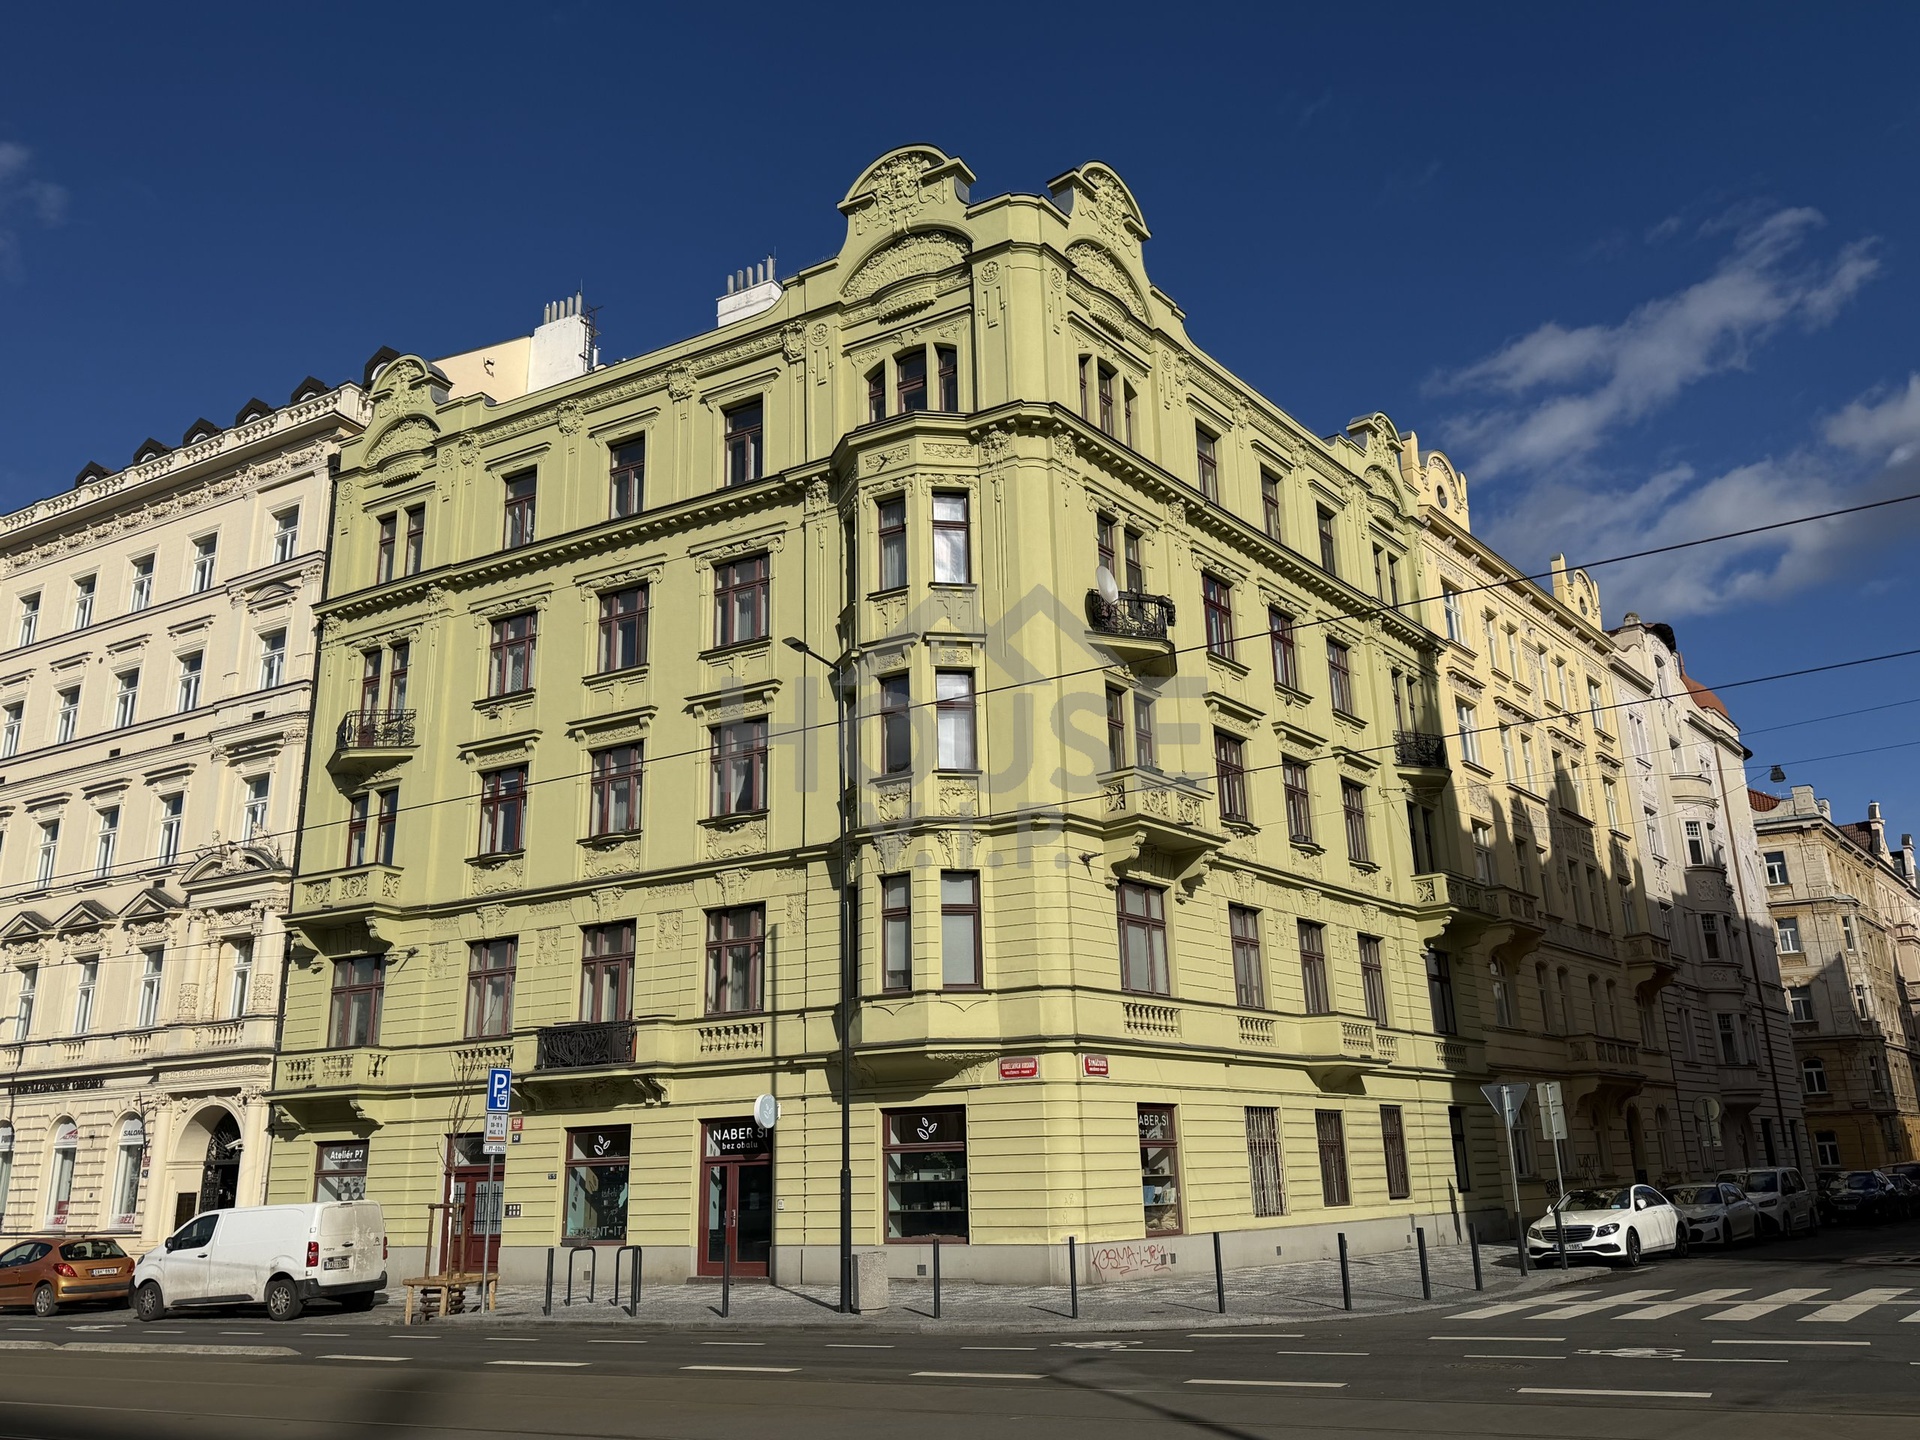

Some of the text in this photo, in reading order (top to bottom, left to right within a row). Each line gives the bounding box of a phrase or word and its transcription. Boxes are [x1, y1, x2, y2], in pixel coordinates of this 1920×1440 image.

[493, 1073, 507, 1097] P
[713, 1127, 768, 1141] NABER SI
[722, 1141, 758, 1150] bez obalu
[330, 1149, 364, 1160] Ateliér P7
